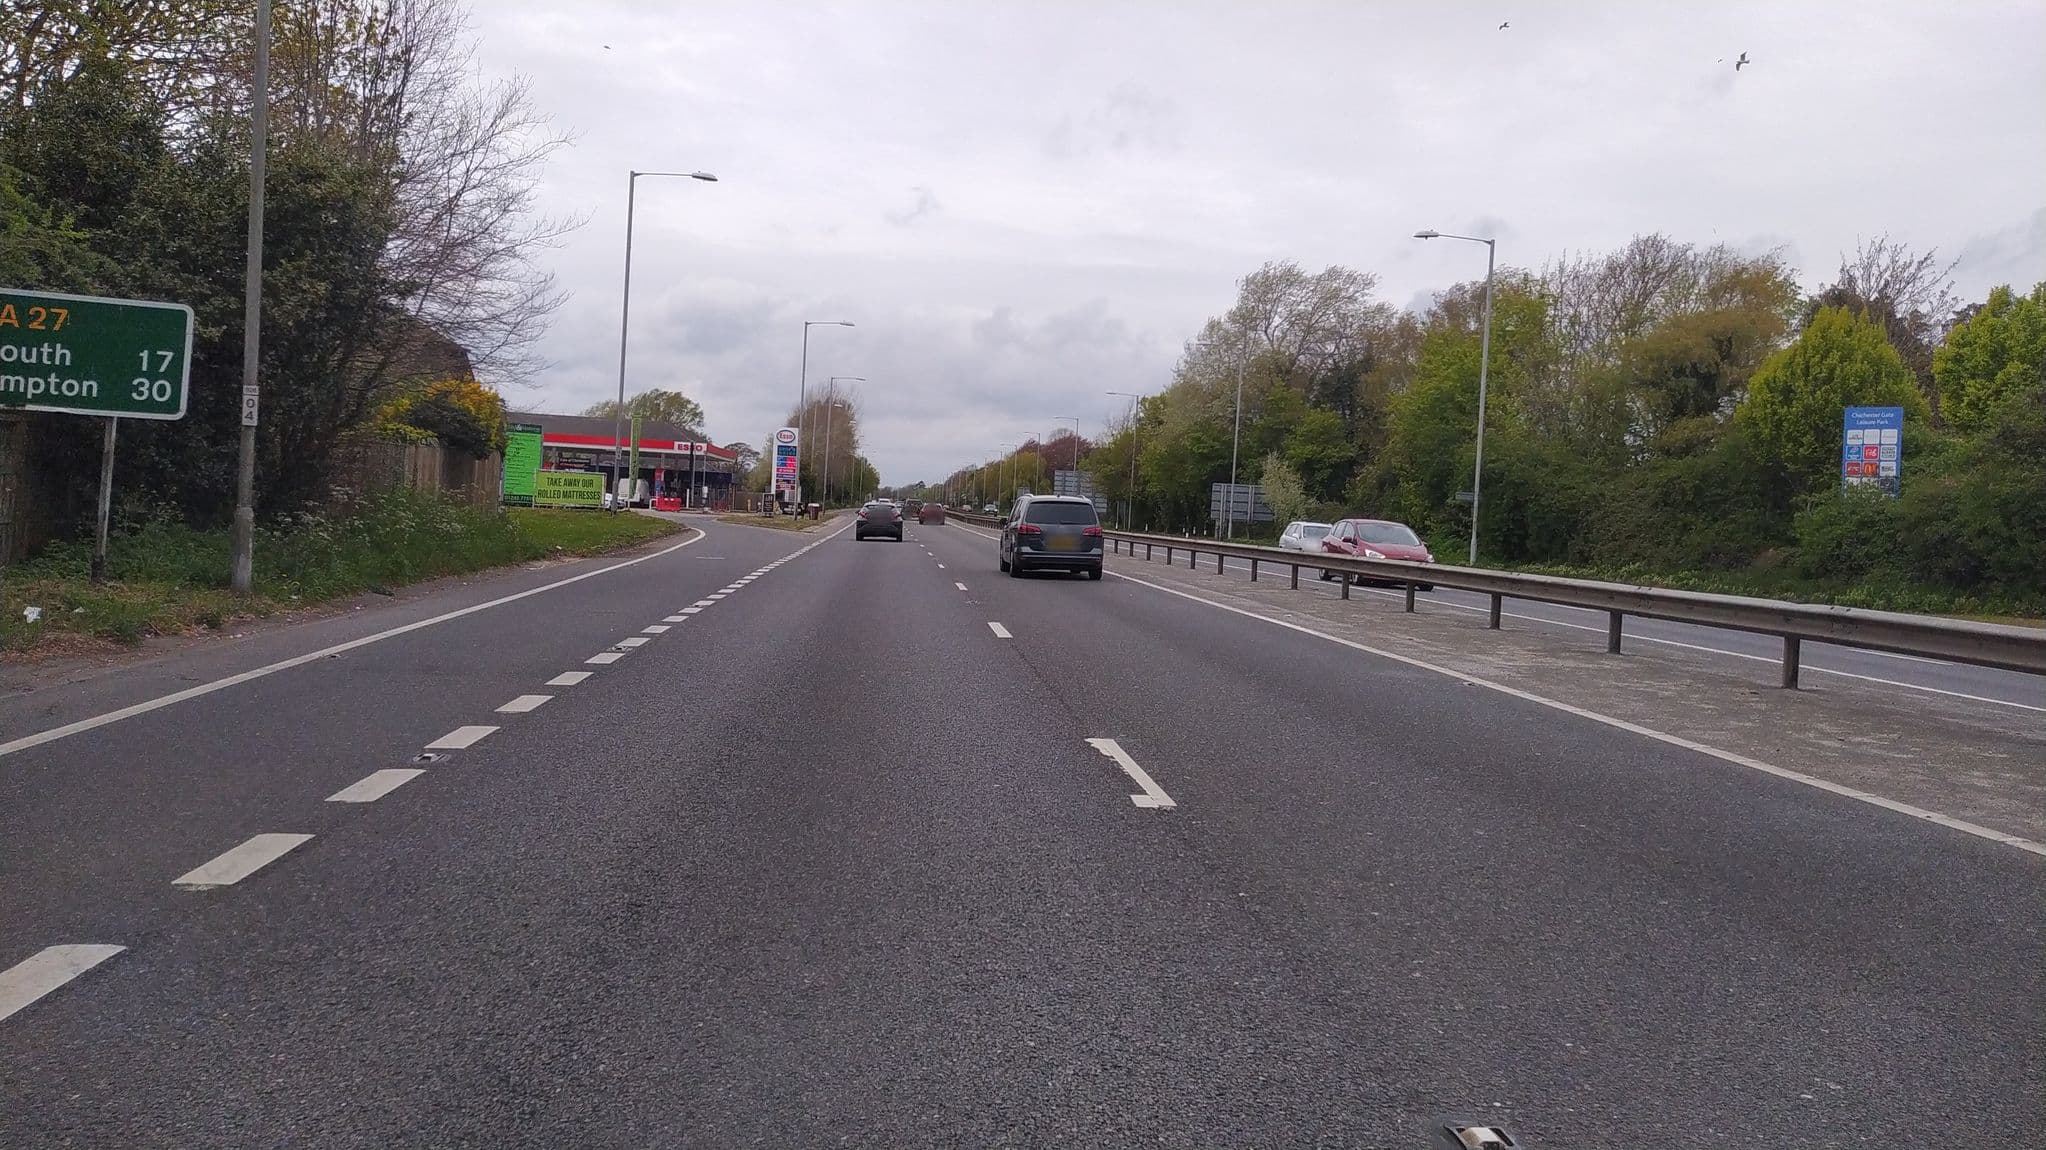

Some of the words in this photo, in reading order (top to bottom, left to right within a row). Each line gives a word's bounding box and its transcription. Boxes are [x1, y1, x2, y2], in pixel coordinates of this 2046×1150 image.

[138, 350, 175, 373] 17
[131, 377, 172, 401] 30
[677, 443, 703, 452] ESO
[546, 477, 562, 486] TAKE
[563, 478, 580, 488] AWAY
[581, 479, 594, 488] OUR
[537, 489, 560, 499] ROLLED
[562, 490, 601, 500] MATTRESSES
